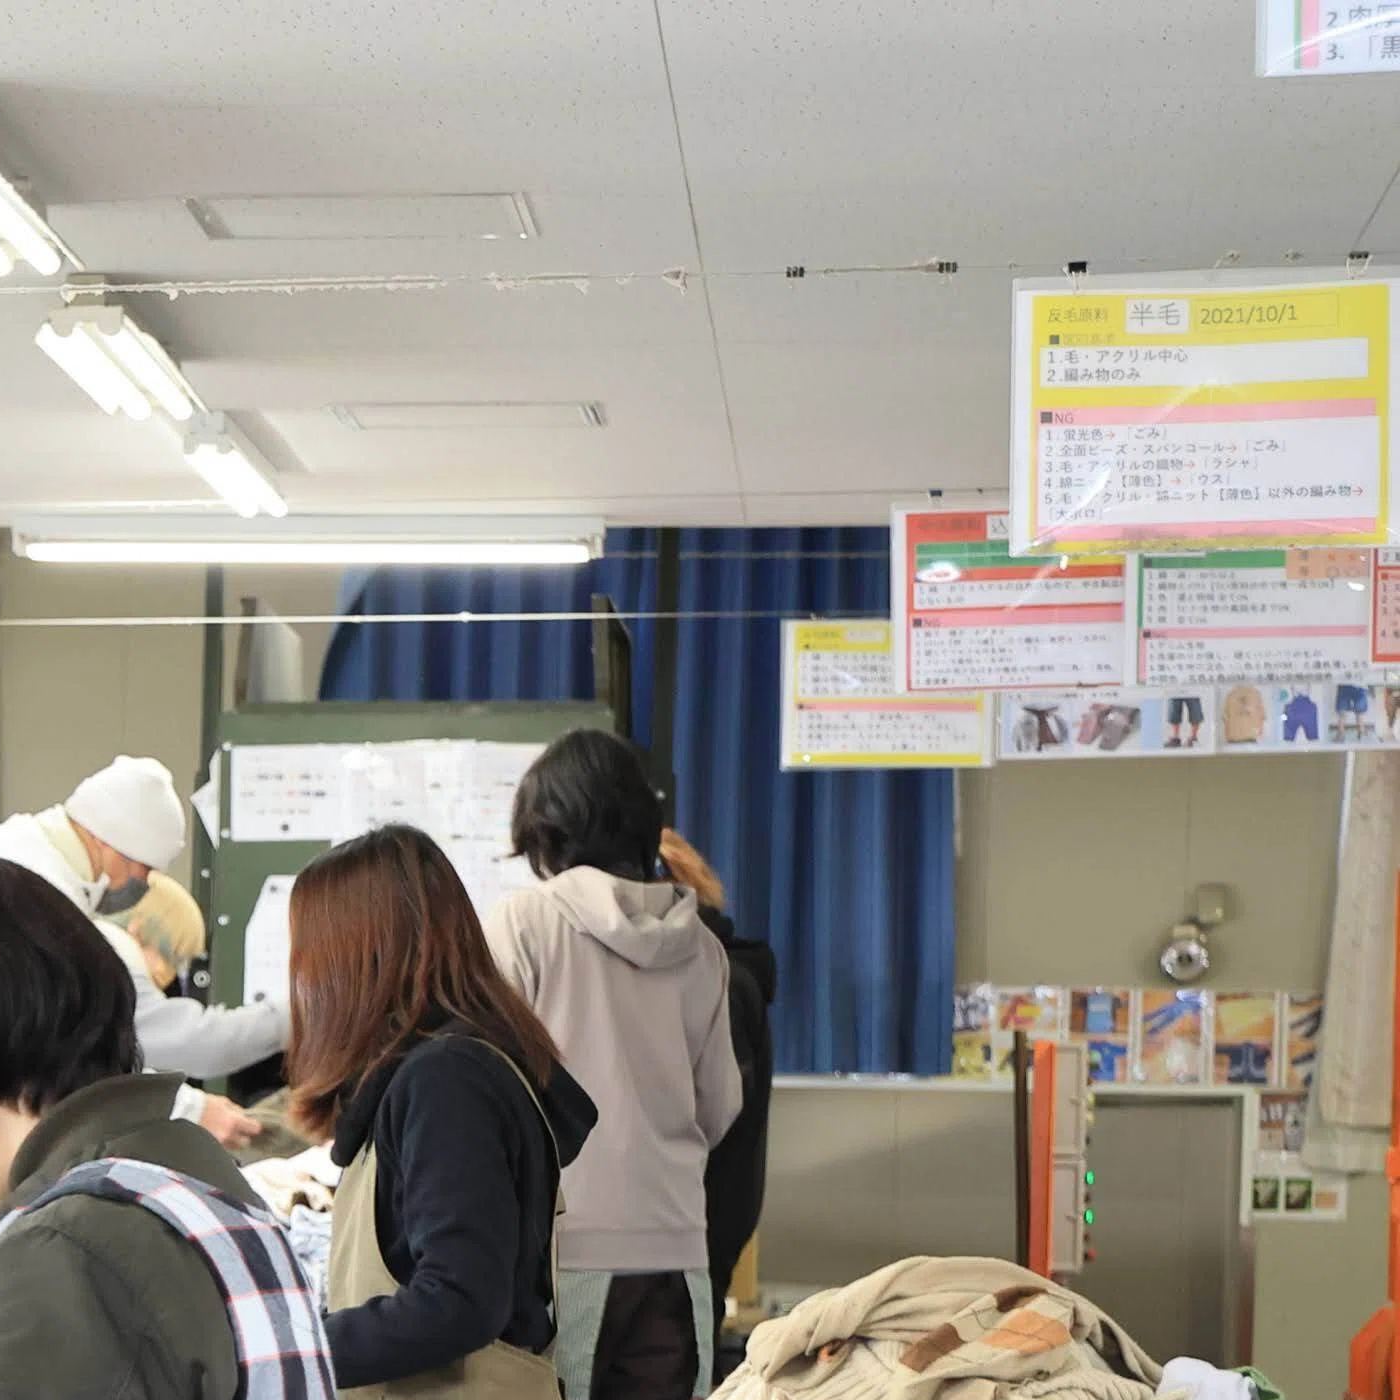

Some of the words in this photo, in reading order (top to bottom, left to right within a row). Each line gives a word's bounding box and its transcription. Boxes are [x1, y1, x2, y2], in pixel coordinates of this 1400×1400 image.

[1129, 301, 1182, 327] 半毛
[1200, 303, 1298, 325] 2021/10/1
[1054, 413, 1074, 425] NG
[1044, 485, 1352, 506] 5.毛・クリル・綿ニット【薄色】以外の編み物
